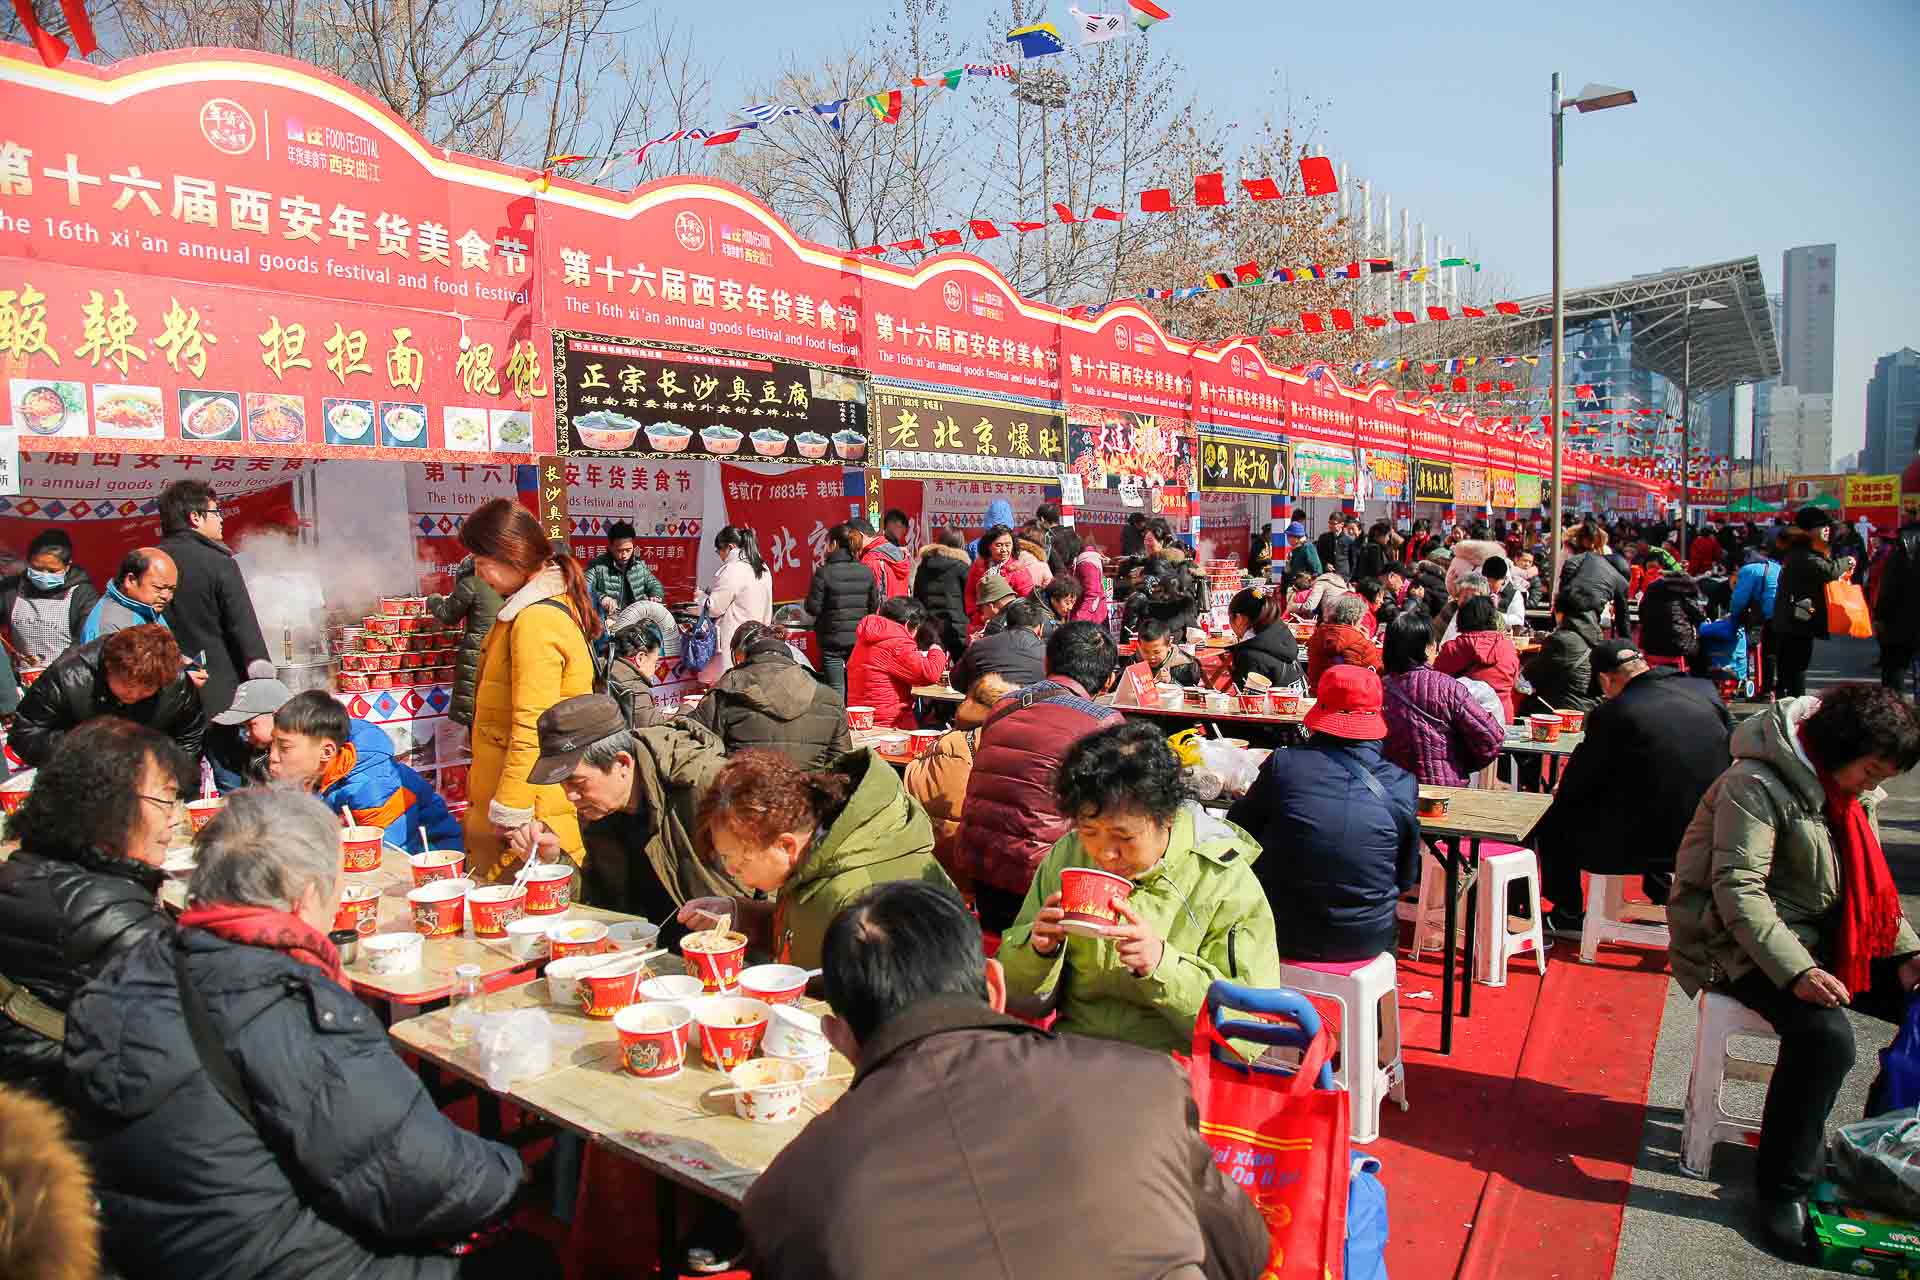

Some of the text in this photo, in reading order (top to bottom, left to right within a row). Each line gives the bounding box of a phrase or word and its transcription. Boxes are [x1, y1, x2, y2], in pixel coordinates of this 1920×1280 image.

[287, 144, 327, 170] 年货美食节
[325, 127, 347, 151] FOOD
[347, 129, 379, 159] FESTIVAL
[0, 140, 530, 277] 第十六届西安年货美食节
[0, 209, 31, 234] he
[45, 217, 100, 244] 16th
[178, 241, 250, 265] annual
[259, 255, 318, 274] goods
[326, 259, 390, 285] festival
[398, 273, 427, 290] and
[432, 276, 468, 297] food
[475, 283, 529, 305] festival
[560, 247, 858, 336] 第十六届西安年货美食节
[0, 282, 217, 380] 酸辣粉
[258, 314, 424, 393] 担担面
[564, 296, 591, 314] The
[595, 302, 623, 320] 16th
[664, 314, 705, 331] annual
[709, 319, 743, 339] goods
[746, 324, 783, 343] festival
[785, 330, 803, 347] and
[805, 334, 826, 352] food
[828, 338, 859, 357] festival
[874, 311, 1058, 371] 第十六届西安年货美食节
[455, 336, 548, 400] 馄饨
[578, 363, 810, 411] 正宗长沙臭豆腐
[878, 351, 895, 362] The
[896, 354, 914, 366] 16th
[938, 361, 962, 374] annual
[964, 364, 985, 377] goods
[986, 367, 1009, 382] festival
[1010, 372, 1022, 383] and
[887, 408, 1062, 459] 老北京爆肚
[41, 477, 101, 490] annual
[106, 479, 154, 493] goods
[426, 491, 447, 504] The
[450, 492, 477, 505] 16th
[544, 465, 564, 541] 长沙臭豆
[583, 496, 615, 509] festival
[617, 497, 634, 509] and
[728, 480, 763, 501] 老前门
[768, 481, 809, 500] 1883年
